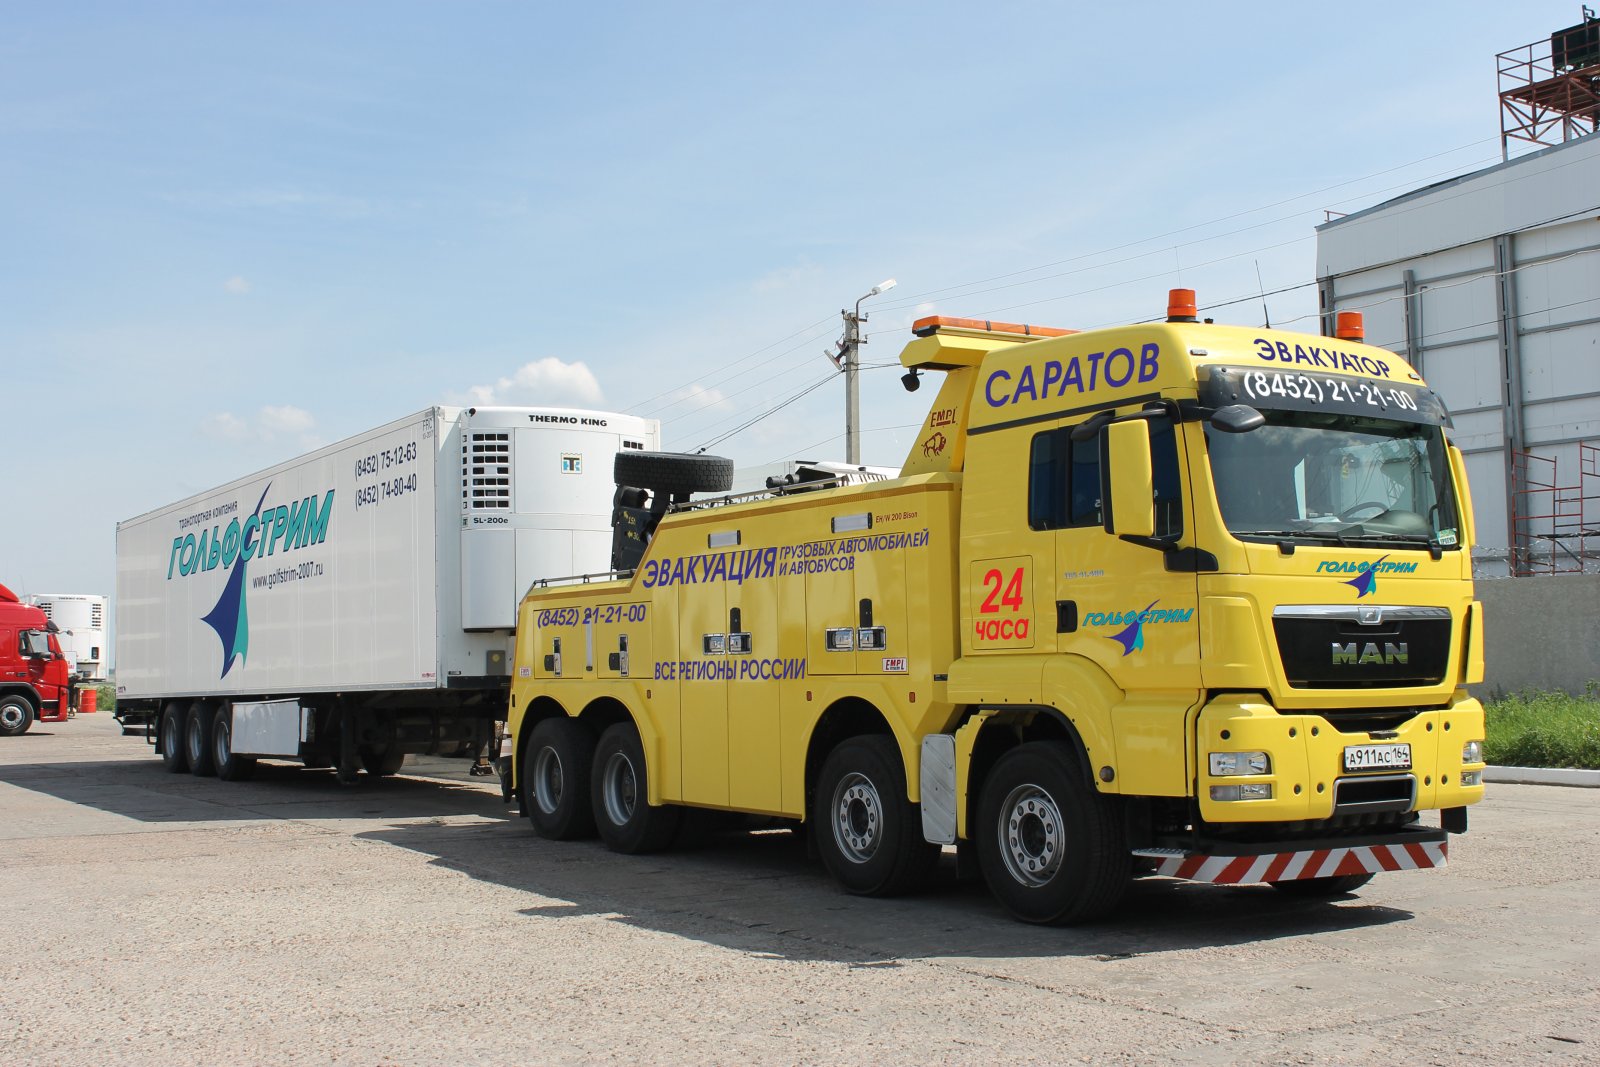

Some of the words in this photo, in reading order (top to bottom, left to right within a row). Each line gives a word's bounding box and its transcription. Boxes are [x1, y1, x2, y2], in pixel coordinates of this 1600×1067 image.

[1253, 338, 1390, 378] ЭВАКУАТОР
[985, 343, 1160, 408] САРАТОВ
[1244, 371, 1324, 403] (8452)
[1326, 379, 1418, 411] 21-21-00
[529, 414, 577, 424] THERMO
[581, 416, 607, 427] KING
[930, 407, 956, 427] EMPL
[355, 454, 379, 481] (8452)
[381, 442, 417, 469] 75-12-63
[355, 484, 379, 512] (8452)
[381, 473, 417, 500] 74-80-40
[179, 510, 212, 532] транспортная
[212, 500, 238, 518] компания
[891, 512, 901, 521] 200
[903, 511, 918, 519] Bison
[167, 489, 335, 580] ГОЛЬФСТРИМ
[779, 541, 836, 560] ГРУЗОВЫХ
[837, 528, 930, 554] АВТОМОБИЛЕЙ
[252, 561, 324, 589] www.golfstrim-2007.ru
[642, 547, 778, 588] ЭВАКУАЦИЯ
[778, 561, 788, 576] И
[788, 556, 855, 575] АВТОБУСОВ
[1316, 560, 1418, 574] ГОЛЬФСТРИМ
[980, 567, 1025, 613] 24
[537, 608, 579, 629] (8452)
[581, 604, 646, 625] 21-21-00
[1082, 608, 1195, 627] ГОЛЬФСТРИМ
[975, 618, 1029, 641] часа
[885, 659, 905, 671] EMPL
[1331, 642, 1409, 665] MAN
[654, 661, 677, 681] ВСЕ
[678, 660, 738, 680] РЕГИОНЫ
[740, 658, 806, 680] РОССИИ
[1349, 748, 1391, 765] А911АС
[1392, 746, 1409, 759] 164
